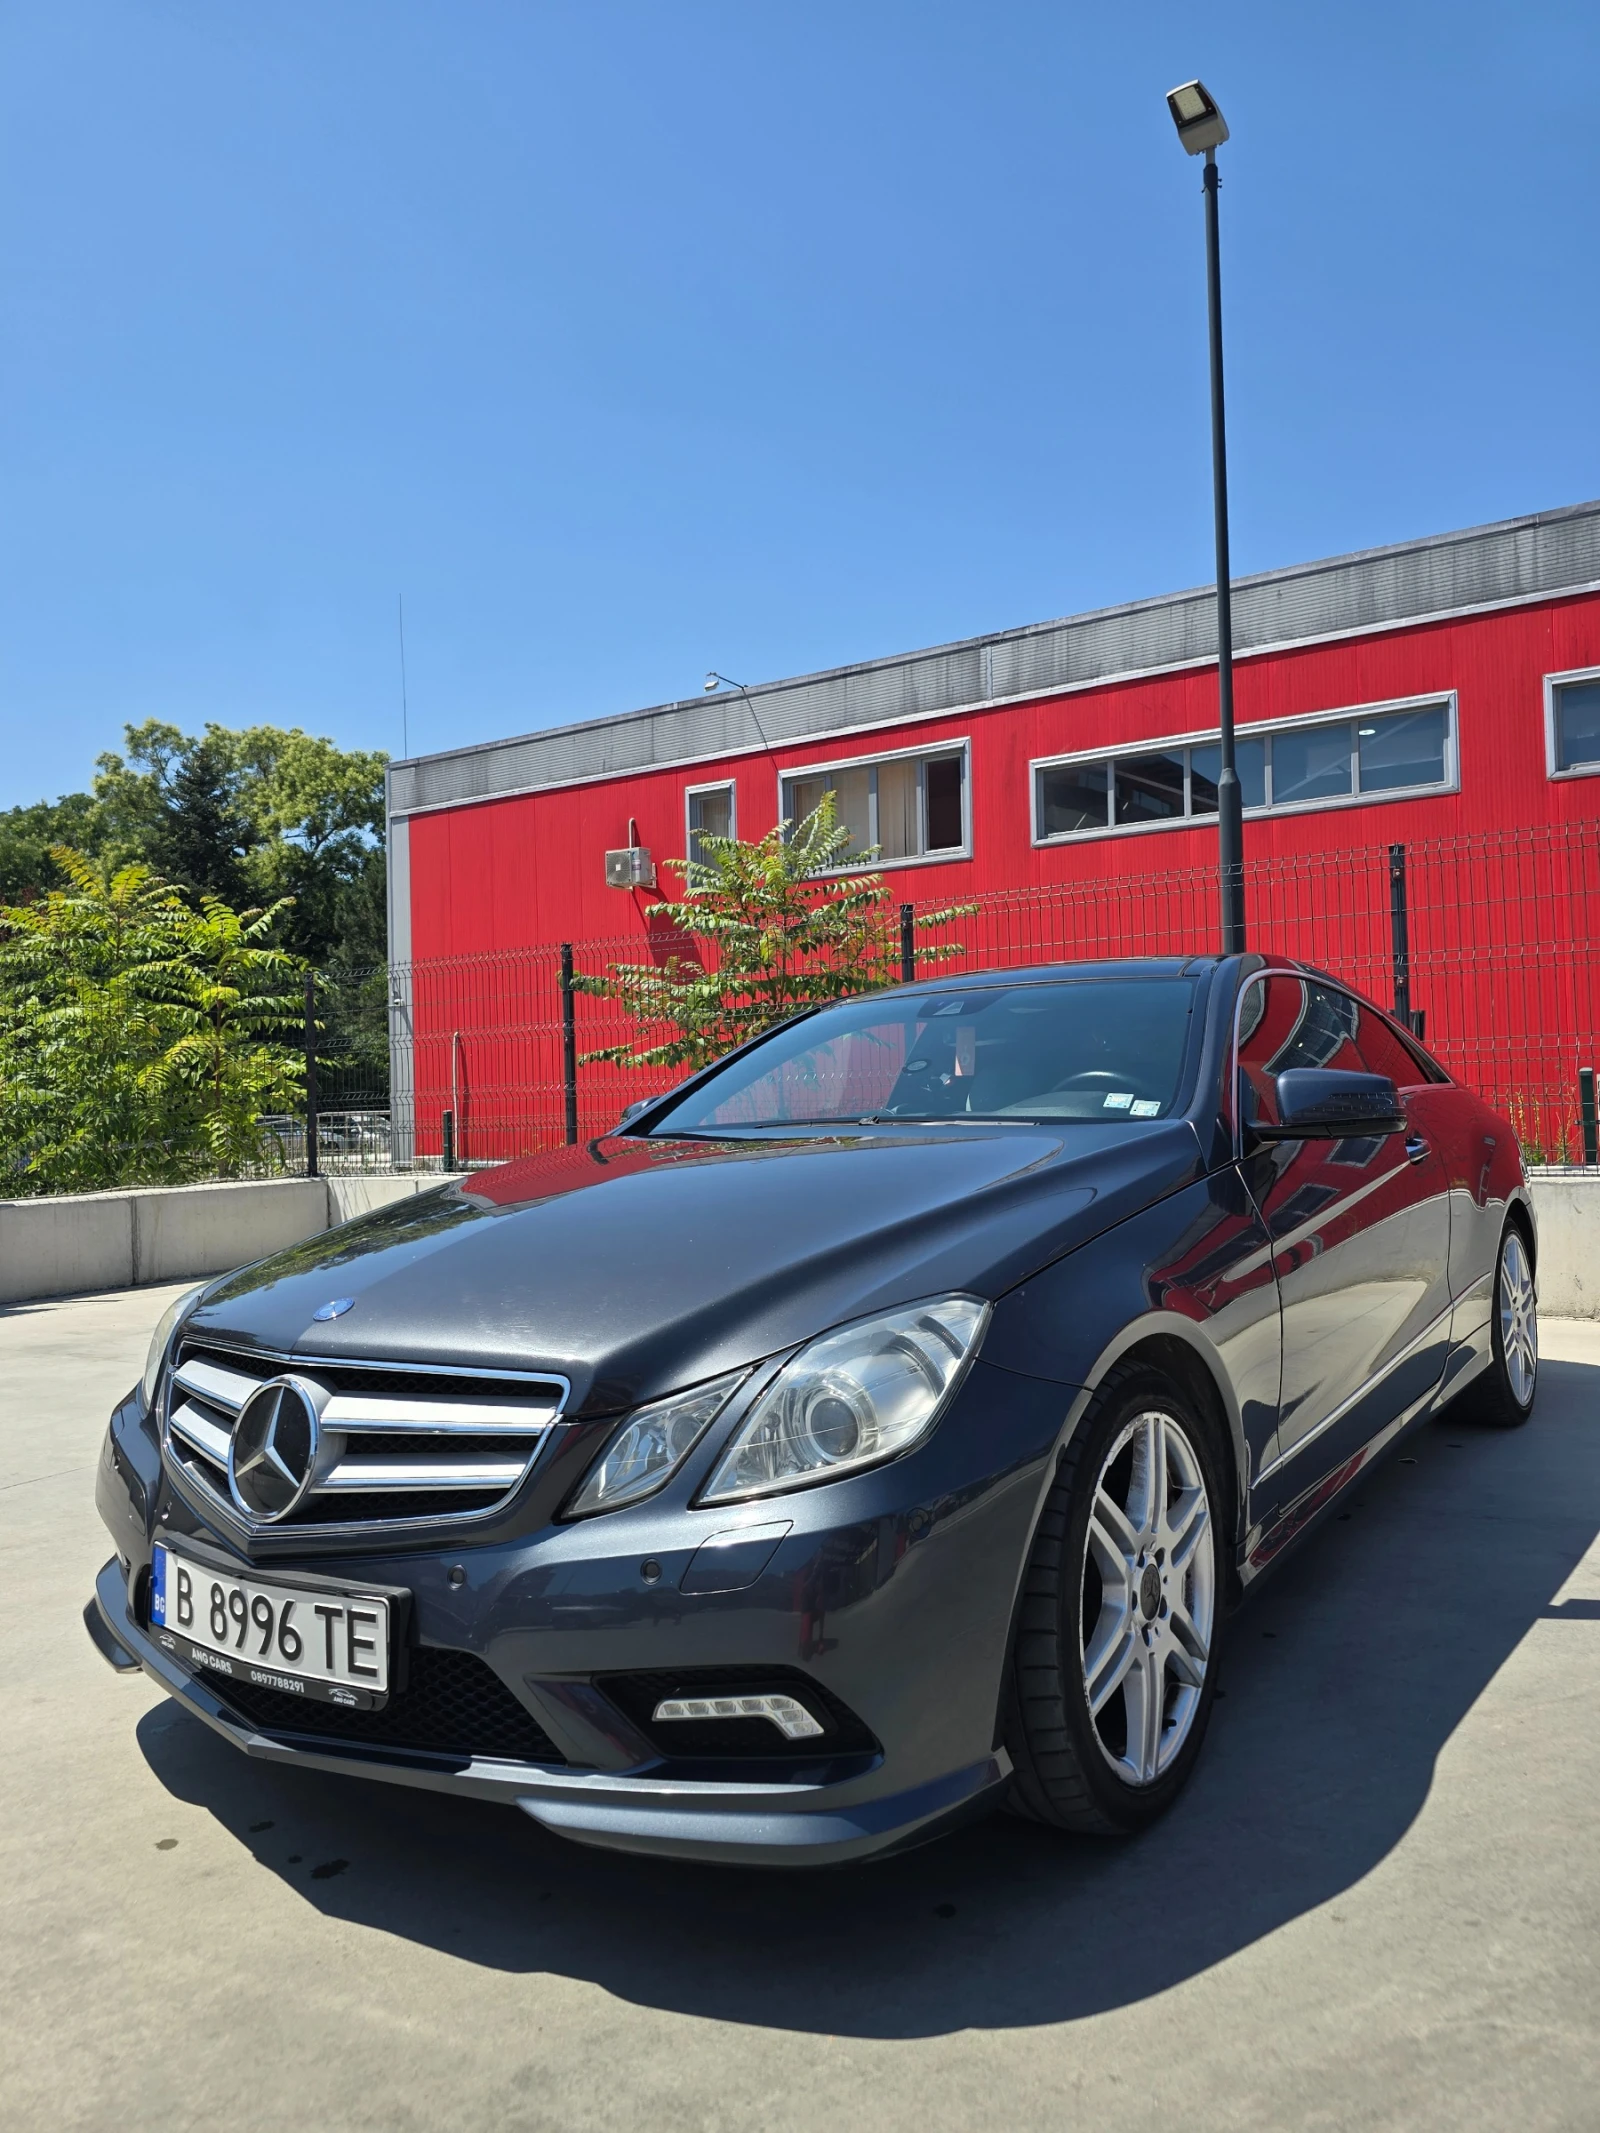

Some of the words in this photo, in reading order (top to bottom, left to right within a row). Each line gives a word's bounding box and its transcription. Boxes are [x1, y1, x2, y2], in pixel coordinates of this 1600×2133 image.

[154, 1593, 165, 1614] BG
[177, 1564, 193, 1627] B
[210, 1582, 302, 1661] 8996
[314, 1602, 378, 1677] TE
[192, 1647, 208, 1664] ANG
[209, 1655, 232, 1674] CARS
[250, 1670, 304, 1693] 0897788291
